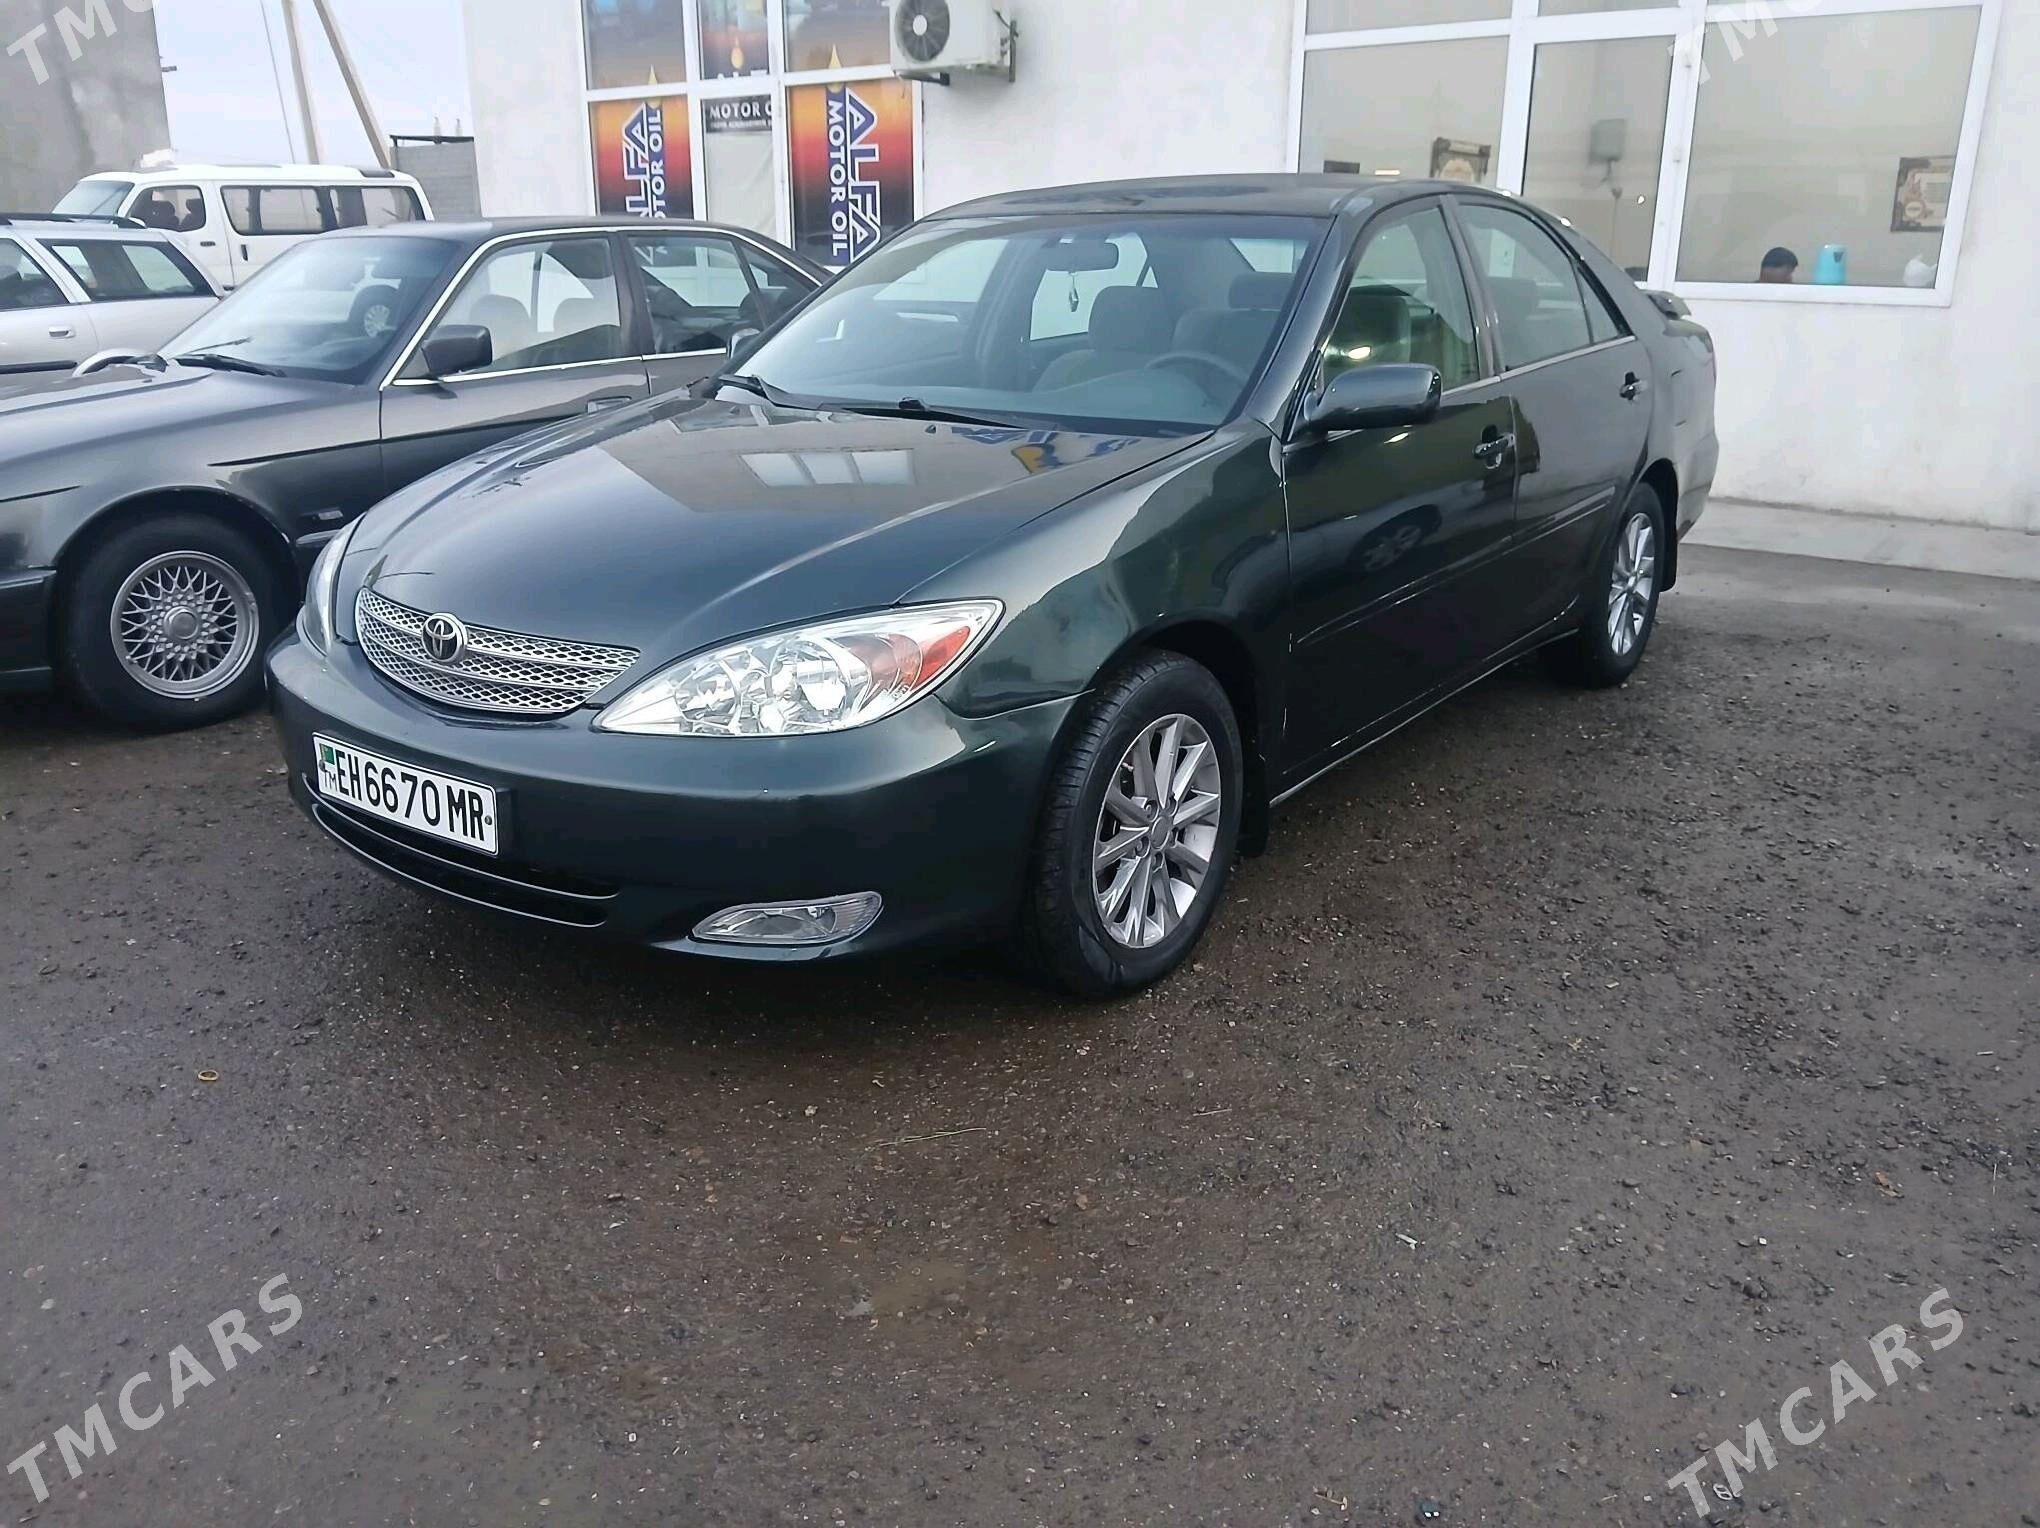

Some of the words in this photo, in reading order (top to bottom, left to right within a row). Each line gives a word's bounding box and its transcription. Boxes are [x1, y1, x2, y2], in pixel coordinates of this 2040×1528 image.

[648, 109, 663, 152] OIL
[709, 101, 761, 119] MOTOR
[623, 102, 653, 218] LFA
[828, 100, 846, 203] MOTOR
[846, 87, 880, 263] ALFA
[831, 210, 848, 257] OIL
